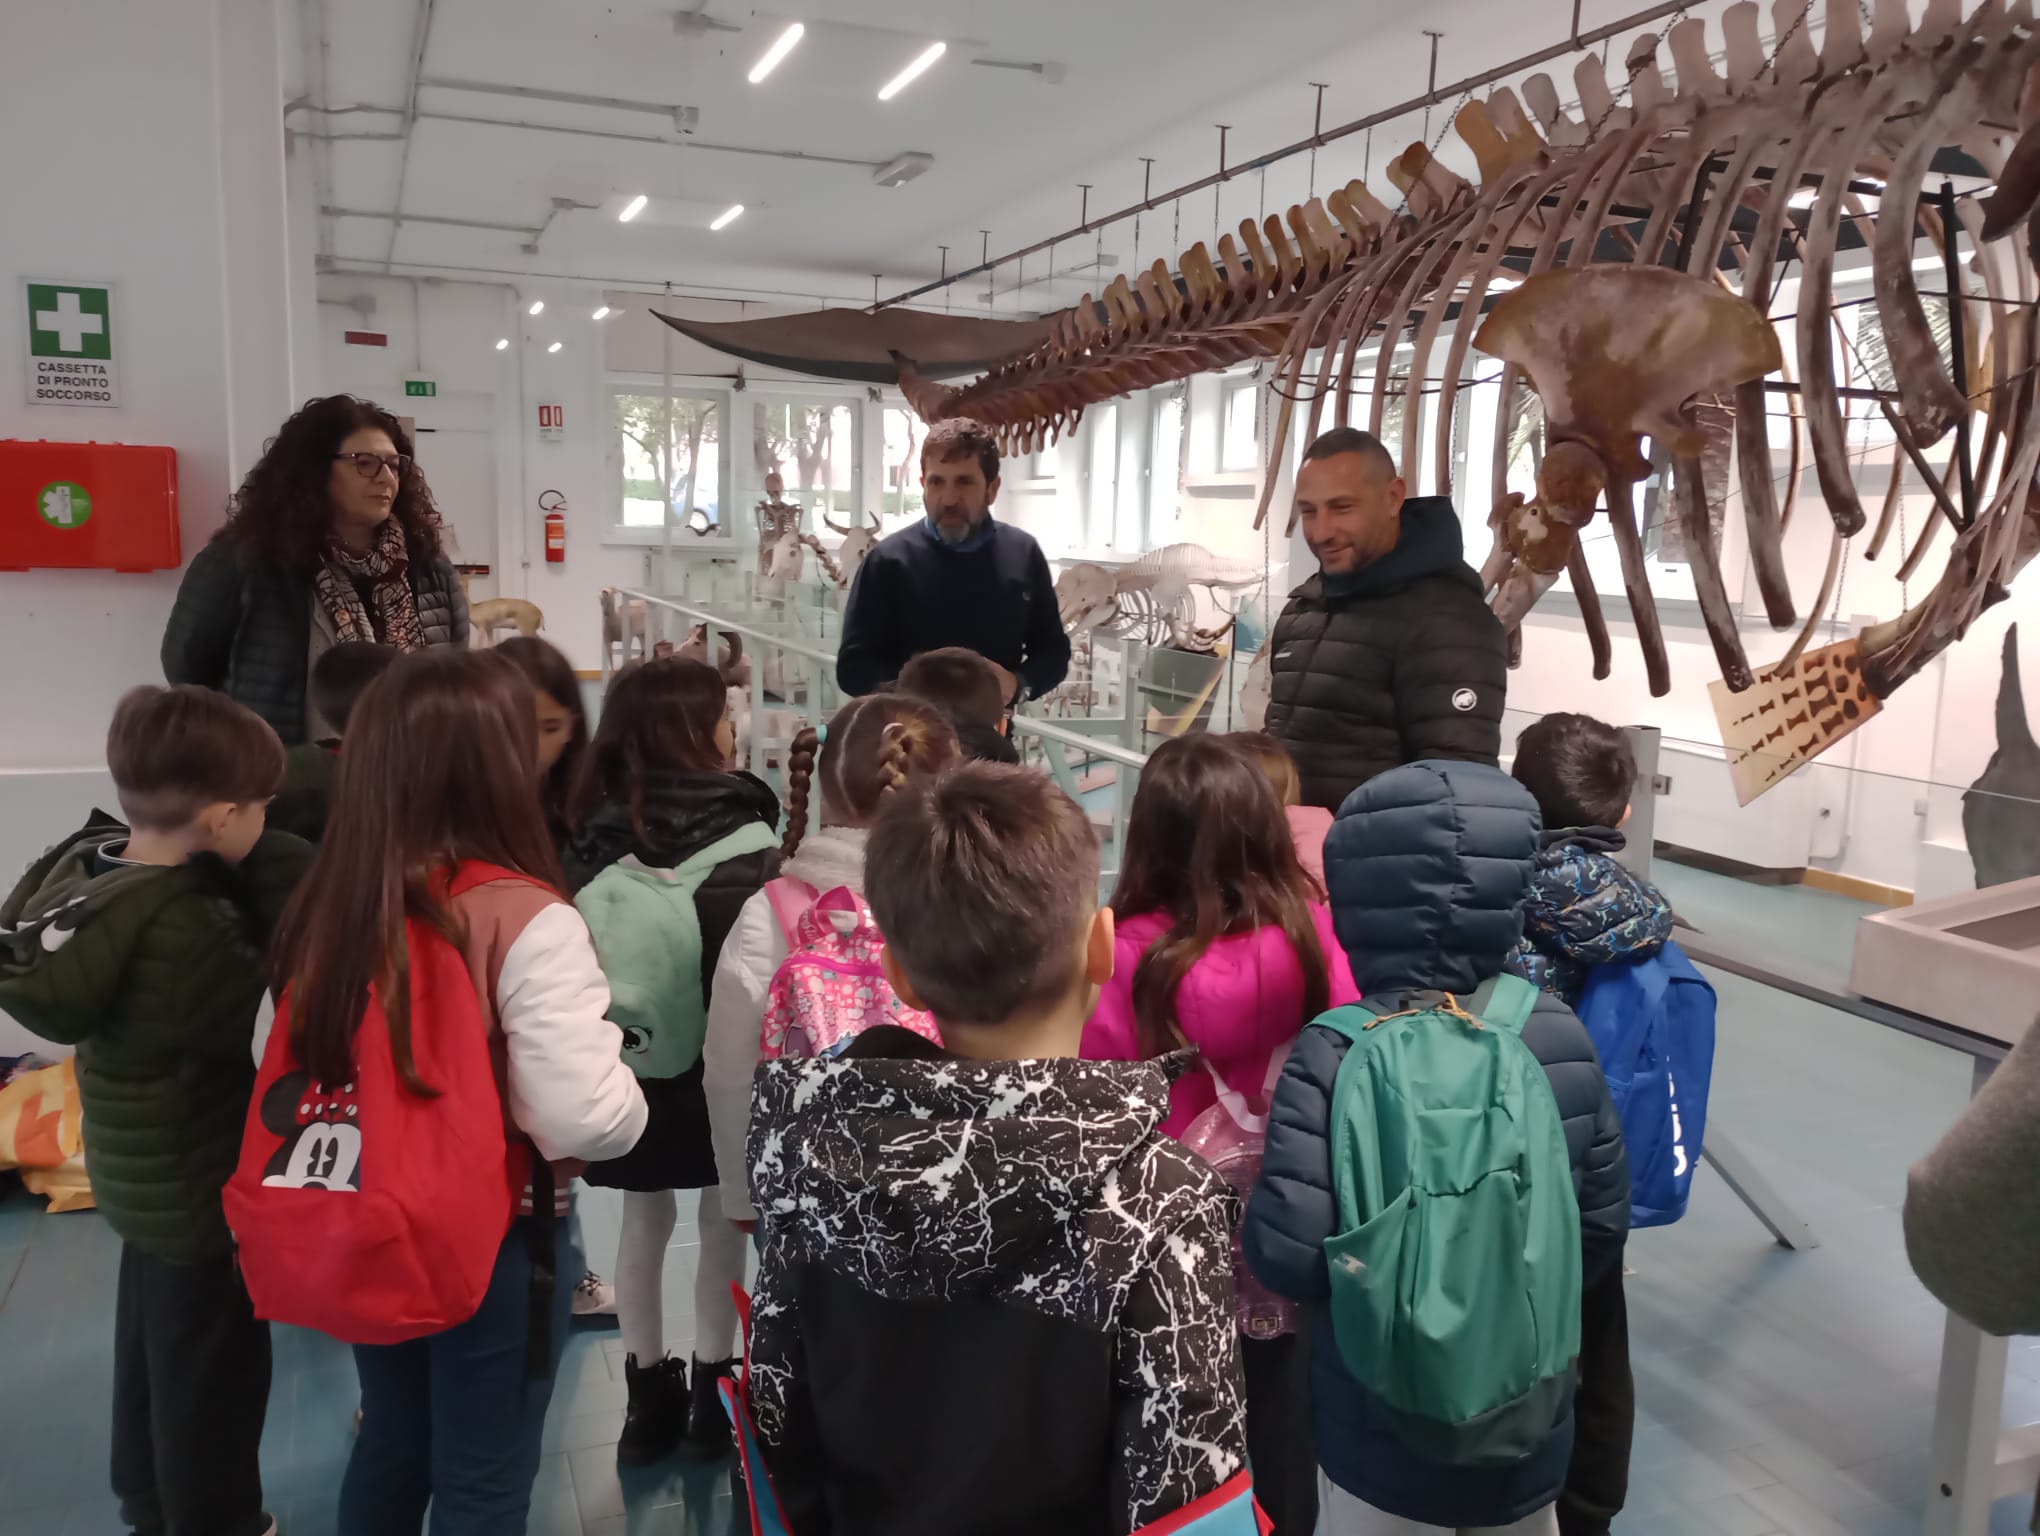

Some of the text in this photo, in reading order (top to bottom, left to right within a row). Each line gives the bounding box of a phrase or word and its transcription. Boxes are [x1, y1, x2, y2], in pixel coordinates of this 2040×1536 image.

[37, 362, 106, 374] CASSETTA
[37, 375, 109, 388] DI PRONTO
[36, 389, 111, 401] SOCCORSO
